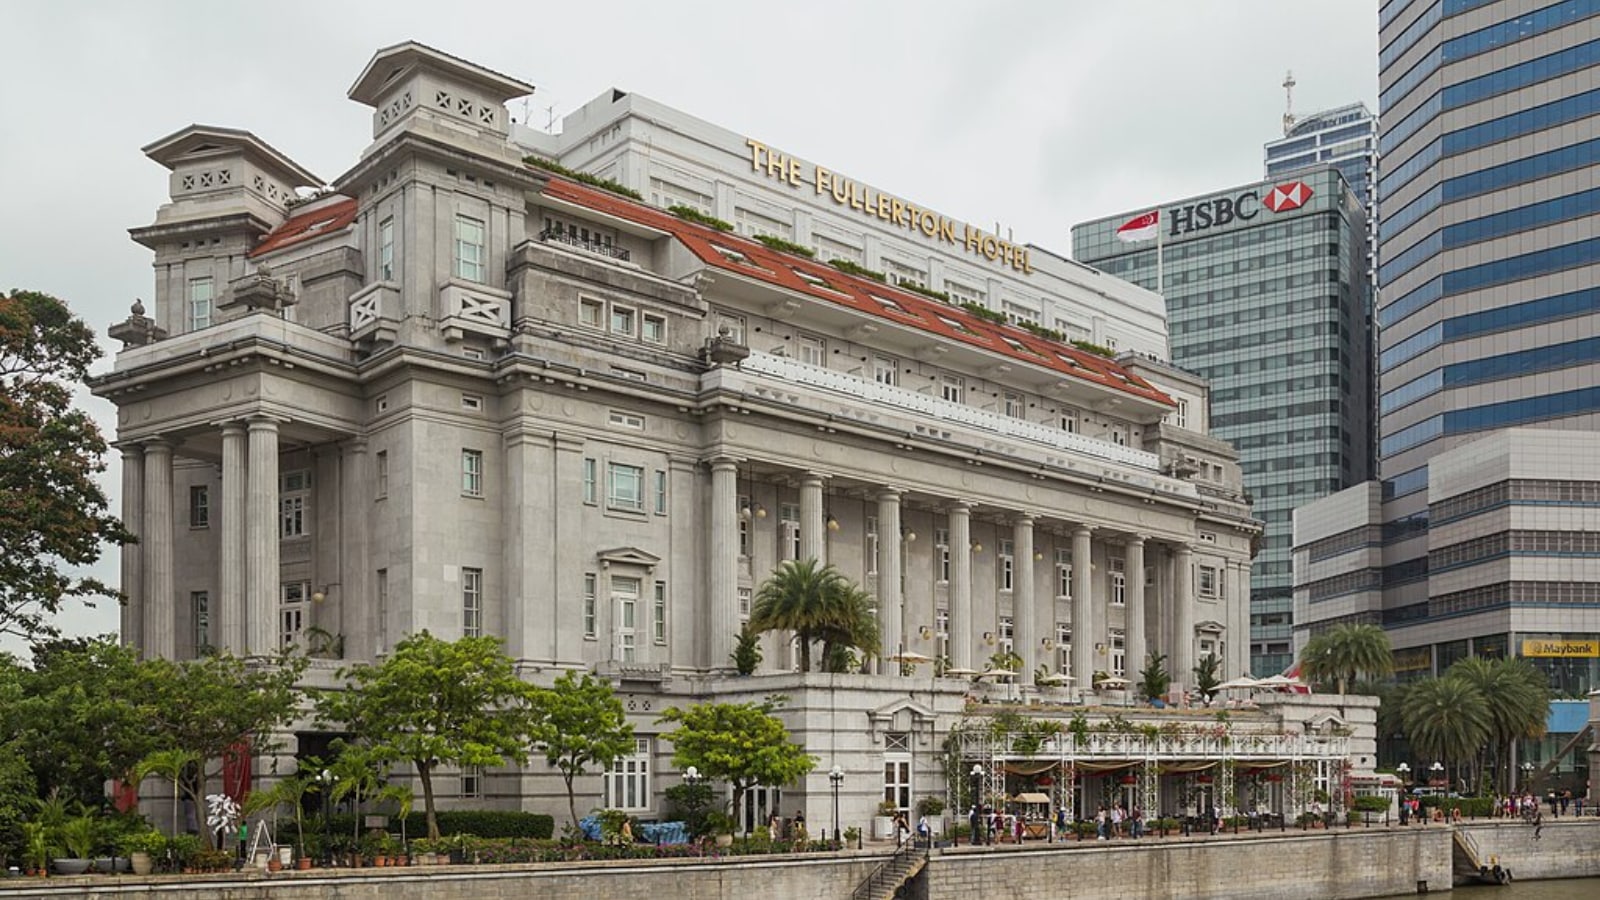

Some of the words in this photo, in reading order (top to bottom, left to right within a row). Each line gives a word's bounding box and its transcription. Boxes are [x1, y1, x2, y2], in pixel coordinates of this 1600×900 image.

[746, 138, 801, 188] THE
[815, 165, 955, 245] FULLERTON
[965, 223, 1034, 273] HOTEL
[1169, 191, 1259, 236] HSBC
[1543, 643, 1593, 656] Maybank
